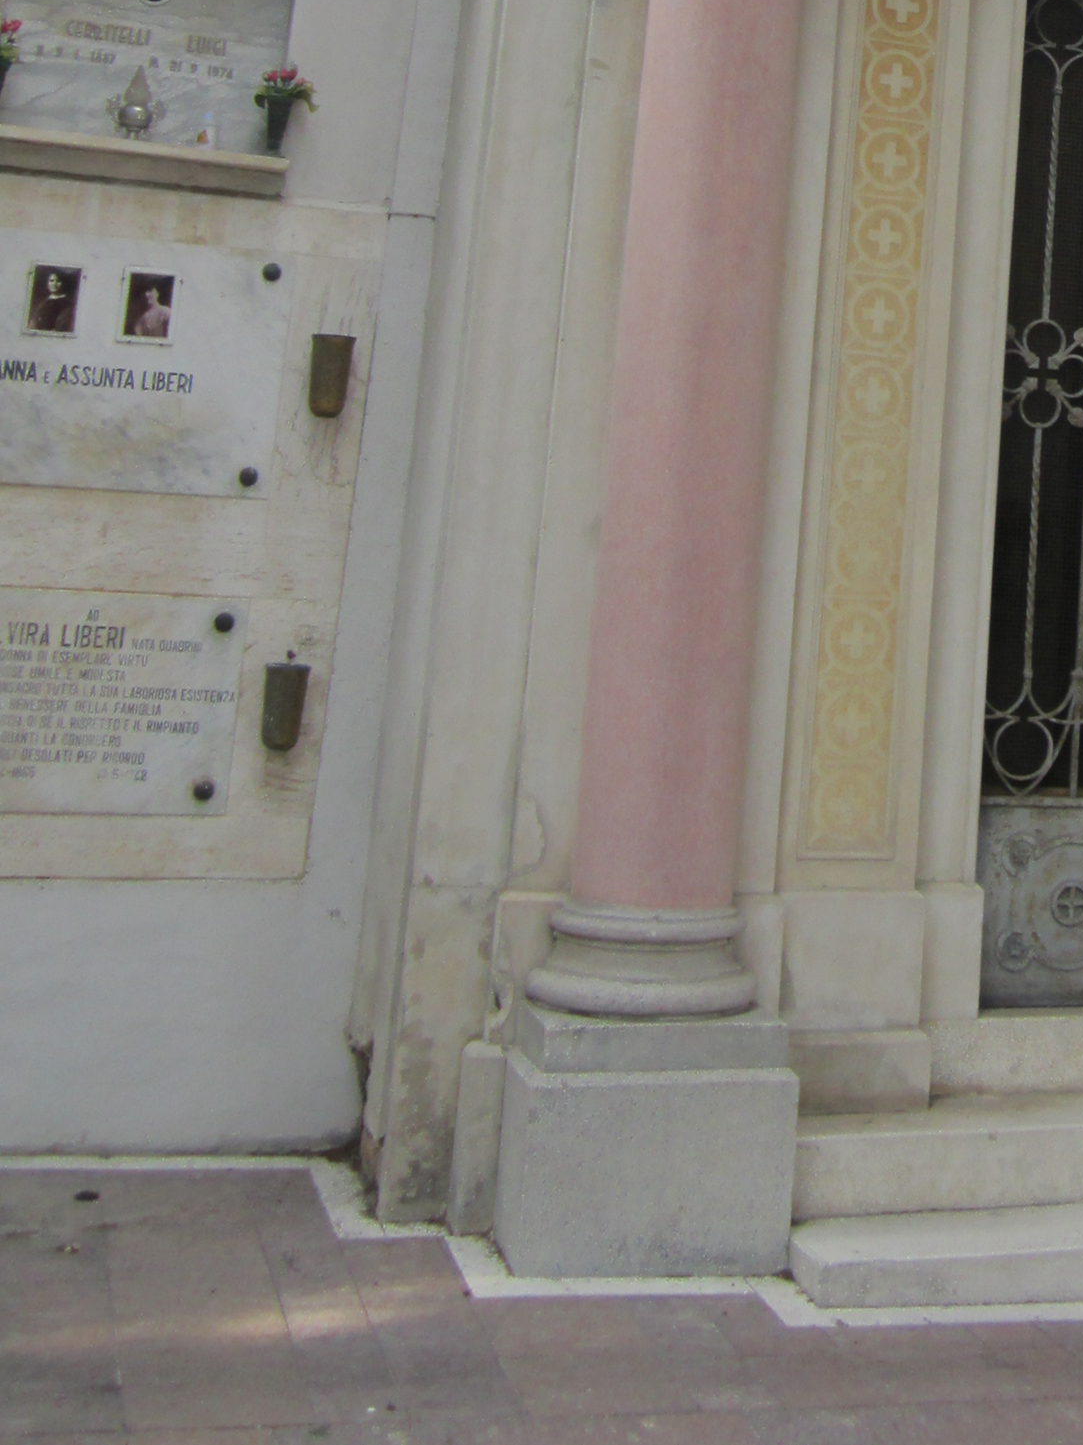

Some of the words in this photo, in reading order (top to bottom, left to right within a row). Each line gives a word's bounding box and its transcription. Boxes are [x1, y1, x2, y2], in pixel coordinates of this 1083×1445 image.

[186, 34, 228, 57] LUIGI
[57, 364, 134, 389] ASSUNTA
[141, 370, 193, 394] LIBERI
[60, 623, 126, 649] LIBERI
[131, 638, 155, 651] NATA
[122, 687, 177, 701] LABORIOSA
[180, 688, 236, 704] ESISTENZA
[114, 701, 162, 716] FAMIGLIA
[146, 720, 201, 735] RIMPIANTO
